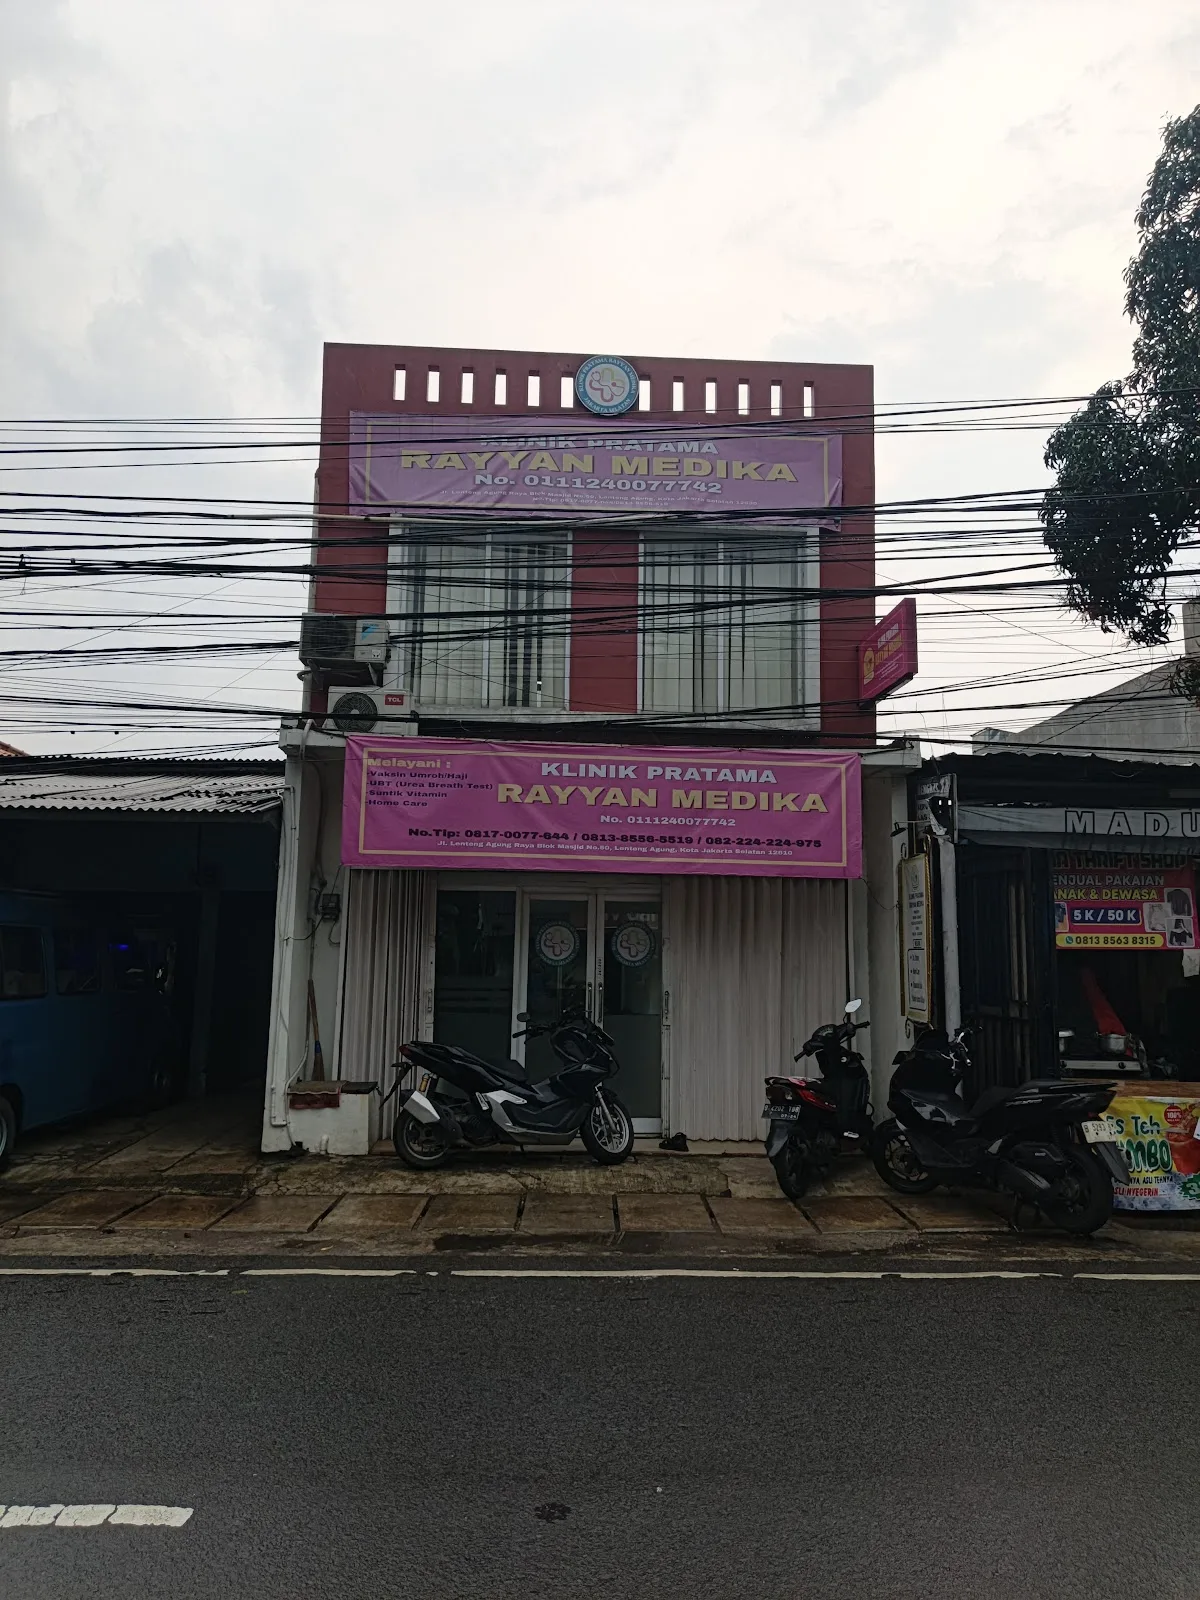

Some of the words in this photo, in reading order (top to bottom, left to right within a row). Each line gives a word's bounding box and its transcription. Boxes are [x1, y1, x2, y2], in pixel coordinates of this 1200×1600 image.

[587, 438, 719, 454] PRATAMA
[401, 449, 595, 473] RAYYAN
[611, 455, 798, 482] MEDIKA
[475, 474, 516, 485] No.
[524, 475, 722, 493] 0111240077742
[367, 758, 441, 770] Melayani
[410, 771, 468, 780] Umroh/Haji
[541, 762, 638, 780] KLINIK
[647, 766, 778, 784] PRATAMA
[428, 781, 463, 789] Breath
[466, 783, 493, 791] Test)
[407, 790, 447, 798] Vitamin
[497, 783, 658, 808] RAYYAN
[672, 788, 829, 812] MEDIKA
[403, 799, 428, 807] Care
[600, 815, 623, 823] No.
[627, 816, 736, 826] 0111240077742
[464, 829, 569, 840] 0817-0077-644
[573, 832, 578, 841] /
[581, 833, 694, 844] 0813-8556-5519
[697, 836, 702, 845] /
[705, 837, 822, 848] 082-224-224-975
[486, 841, 512, 849] Agung
[614, 845, 648, 853] Lenteng
[1075, 852, 1136, 870] THRIFT
[1139, 853, 1188, 870] SHOP
[1053, 873, 1102, 886] ENJUAL
[1105, 874, 1164, 886] PAKAIAN
[1089, 888, 1099, 900] &
[1102, 888, 1159, 900] DEWASA
[1073, 909, 1082, 921] 5
[1084, 909, 1095, 921] K
[1096, 909, 1105, 922] /
[1107, 909, 1126, 921] 50
[1127, 910, 1137, 921] K
[1075, 936, 1100, 944] 0813
[1103, 936, 1129, 945] 8563
[1132, 936, 1156, 944] 8315
[1167, 1112, 1182, 1120] 100%
[1131, 1115, 1161, 1135] Teh
[1114, 1187, 1125, 1195] SLI
[1126, 1187, 1159, 1197] NYEGERIN
